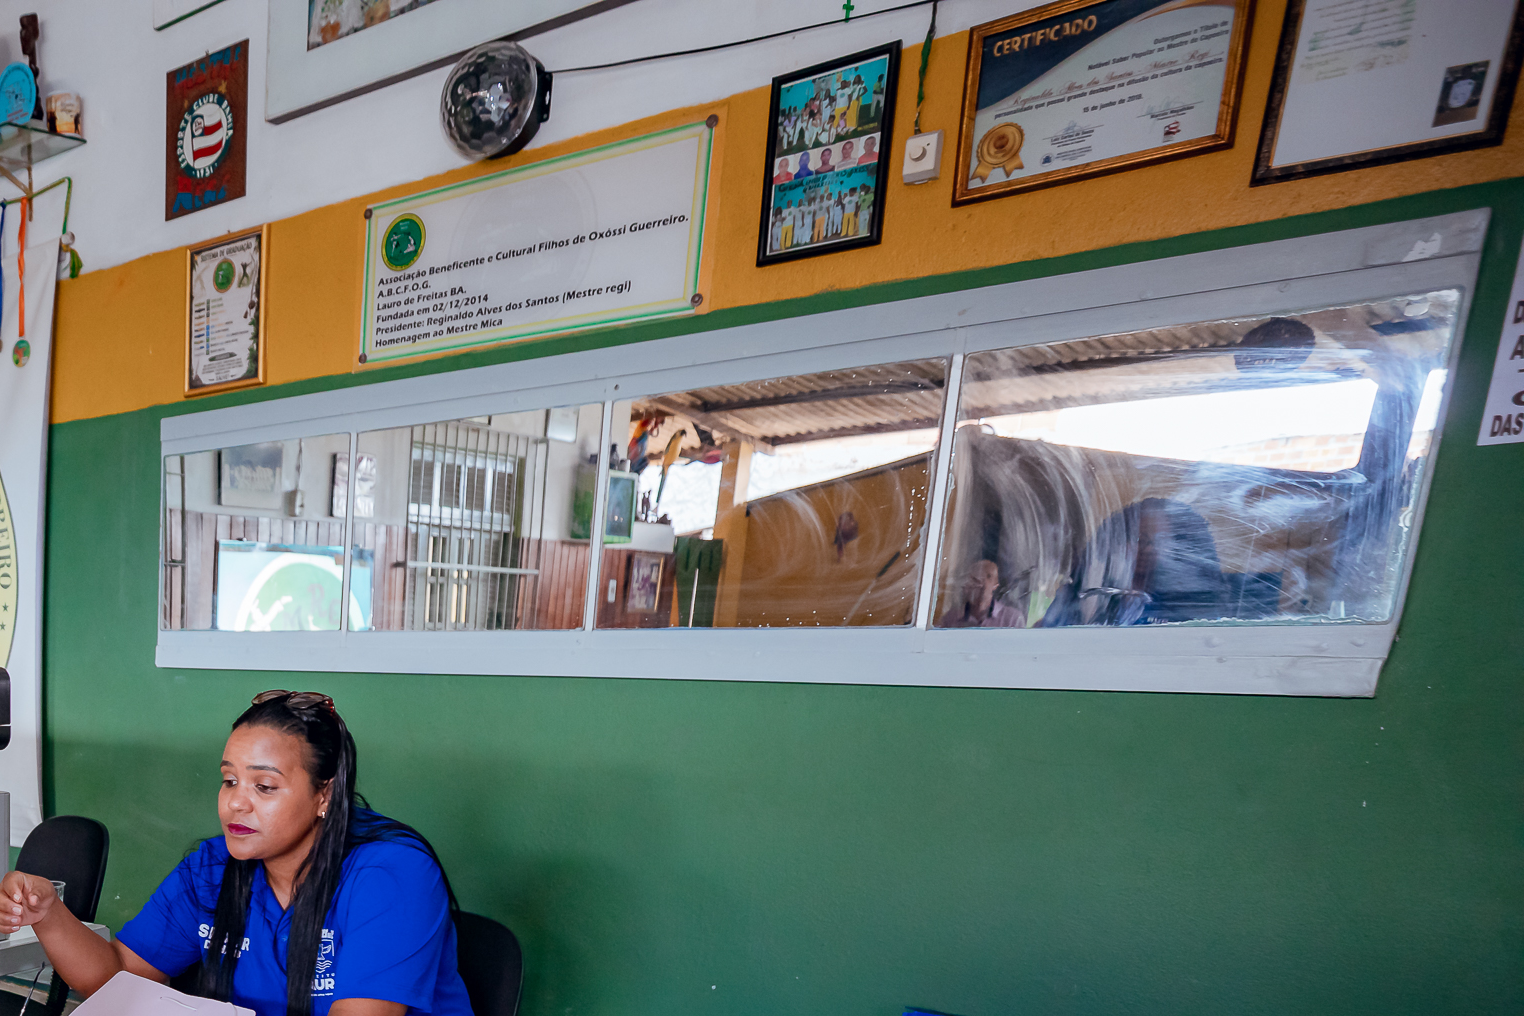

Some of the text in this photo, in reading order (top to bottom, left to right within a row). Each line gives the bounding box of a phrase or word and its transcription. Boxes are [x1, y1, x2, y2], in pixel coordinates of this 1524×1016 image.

[993, 15, 1097, 57] CERTIFICADO
[176, 93, 234, 169] ESPORTE CLUBE BAHIA
[220, 248, 225, 257] DE
[377, 269, 426, 286] Associação
[428, 257, 486, 276] Beneficente
[496, 244, 536, 261] Cultural
[538, 238, 570, 252] Filhos
[572, 234, 586, 245] de
[588, 224, 626, 241] Oxóssi
[628, 214, 688, 232] Guerreiro.
[377, 280, 431, 299] A.B.C.F.O.G.
[377, 286, 467, 311] Lauro de Freitas BA.
[376, 280, 632, 336] Presidente: Reginaldo Alves dos Santos (Mestre regi)
[376, 294, 489, 323] Fundada em 02/12/2014
[375, 317, 503, 348] Homenagem ao Mestre Mica
